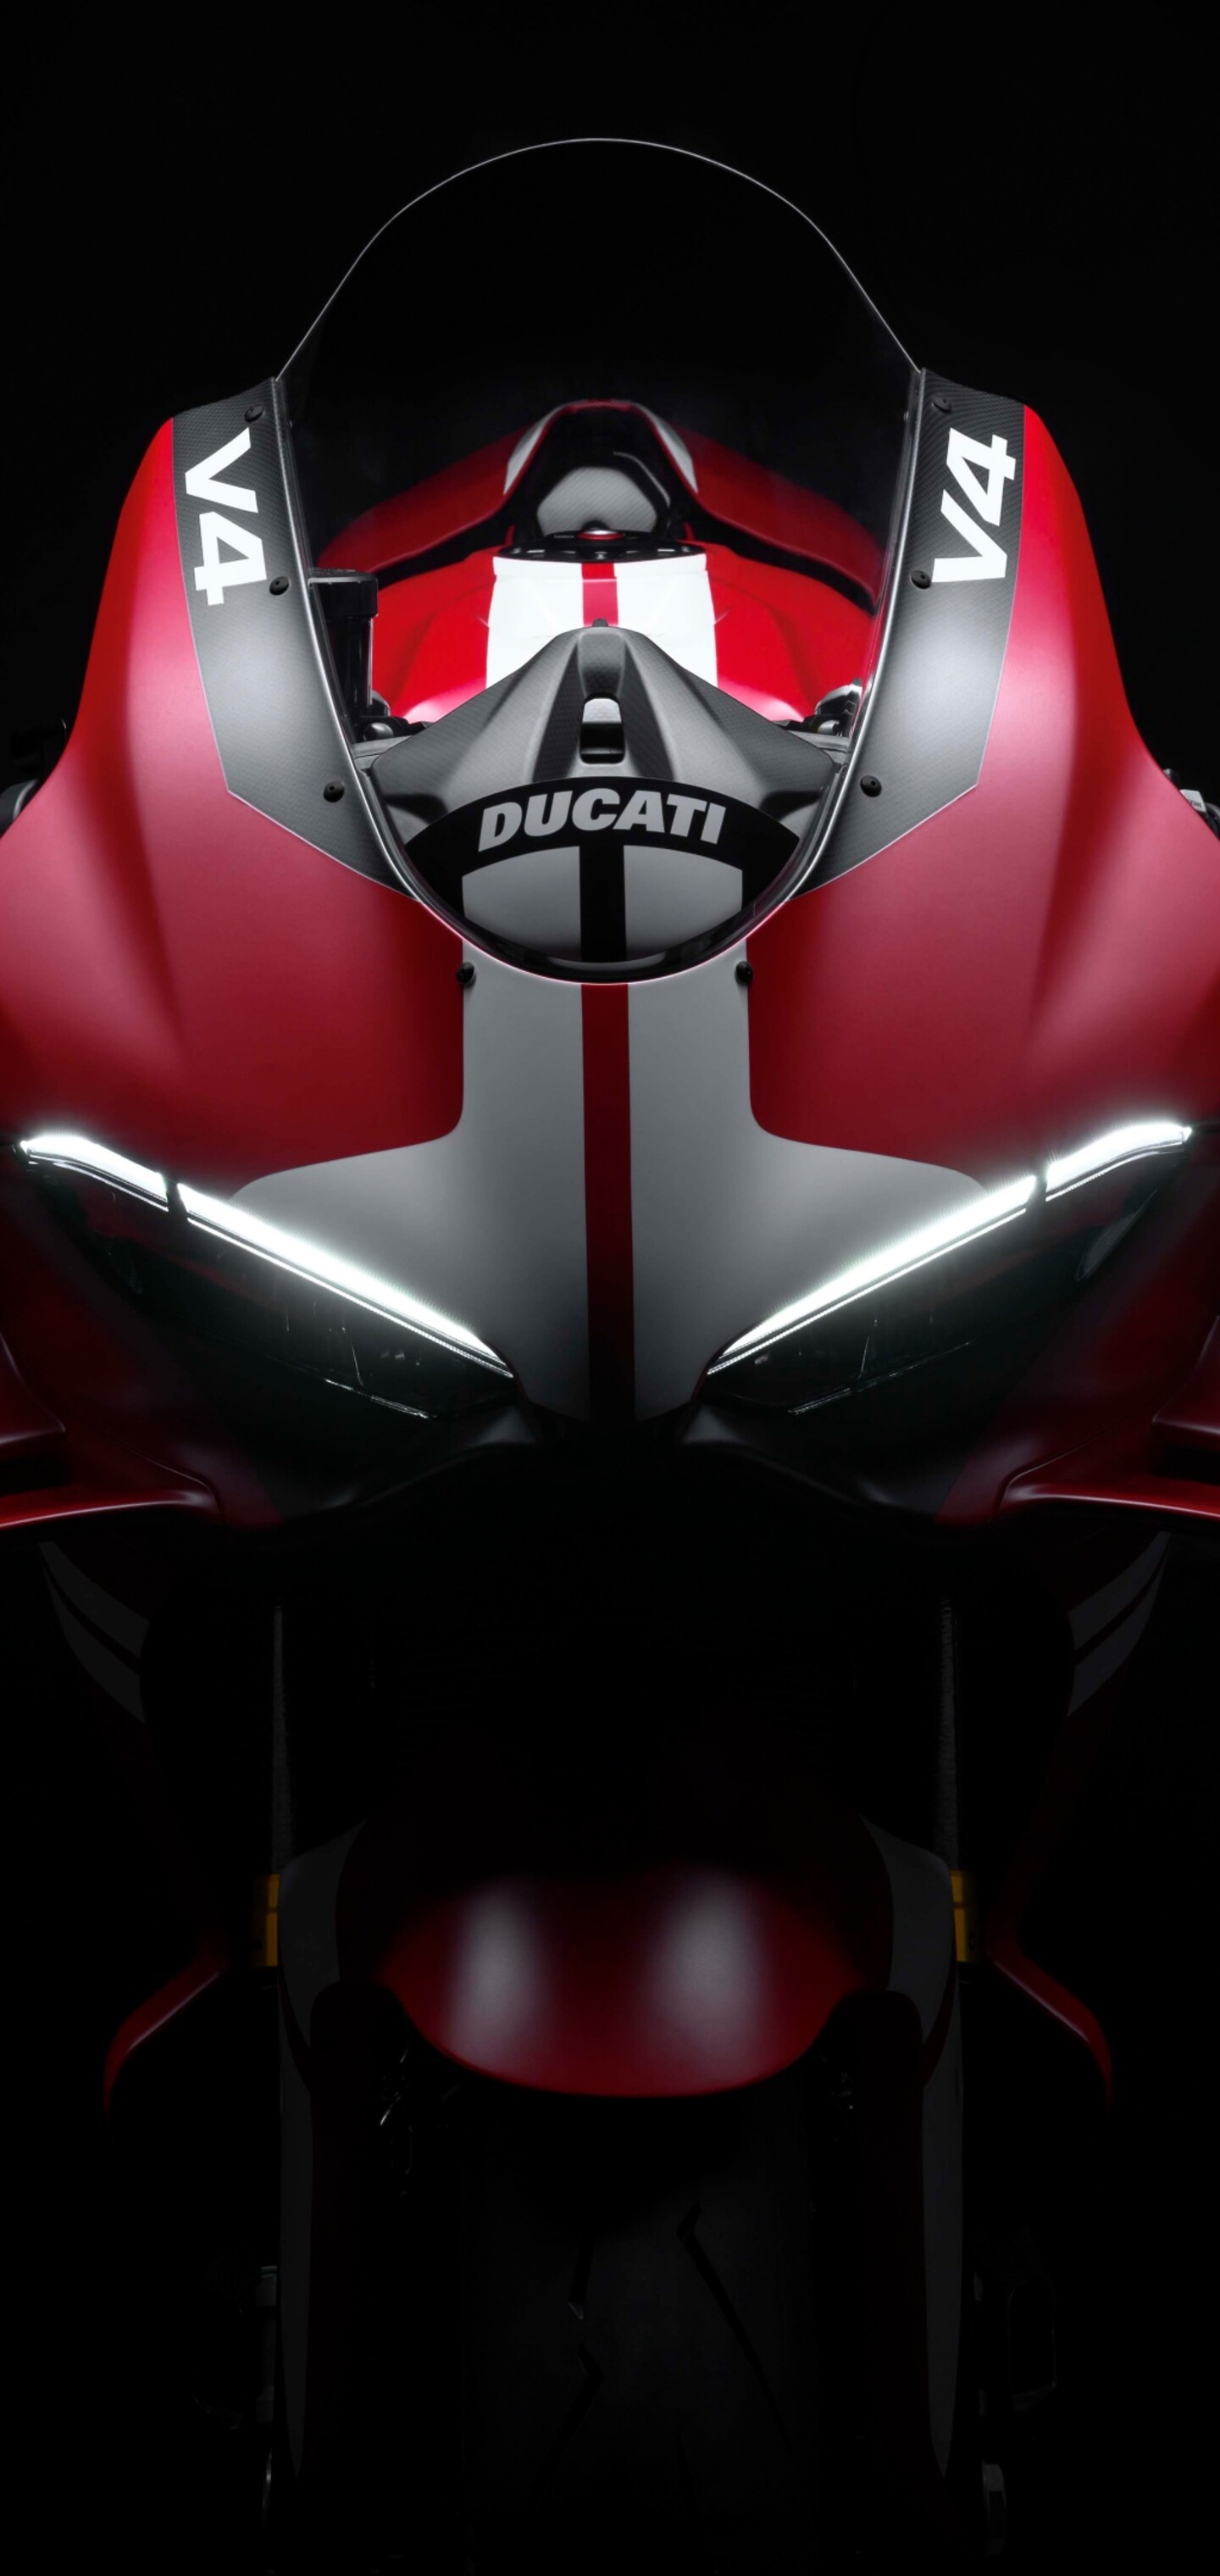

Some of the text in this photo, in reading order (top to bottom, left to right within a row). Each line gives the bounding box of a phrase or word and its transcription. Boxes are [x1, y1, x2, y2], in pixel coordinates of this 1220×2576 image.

[184, 426, 268, 606] V4
[931, 426, 1017, 583] V4
[478, 787, 727, 853] DUCATI
